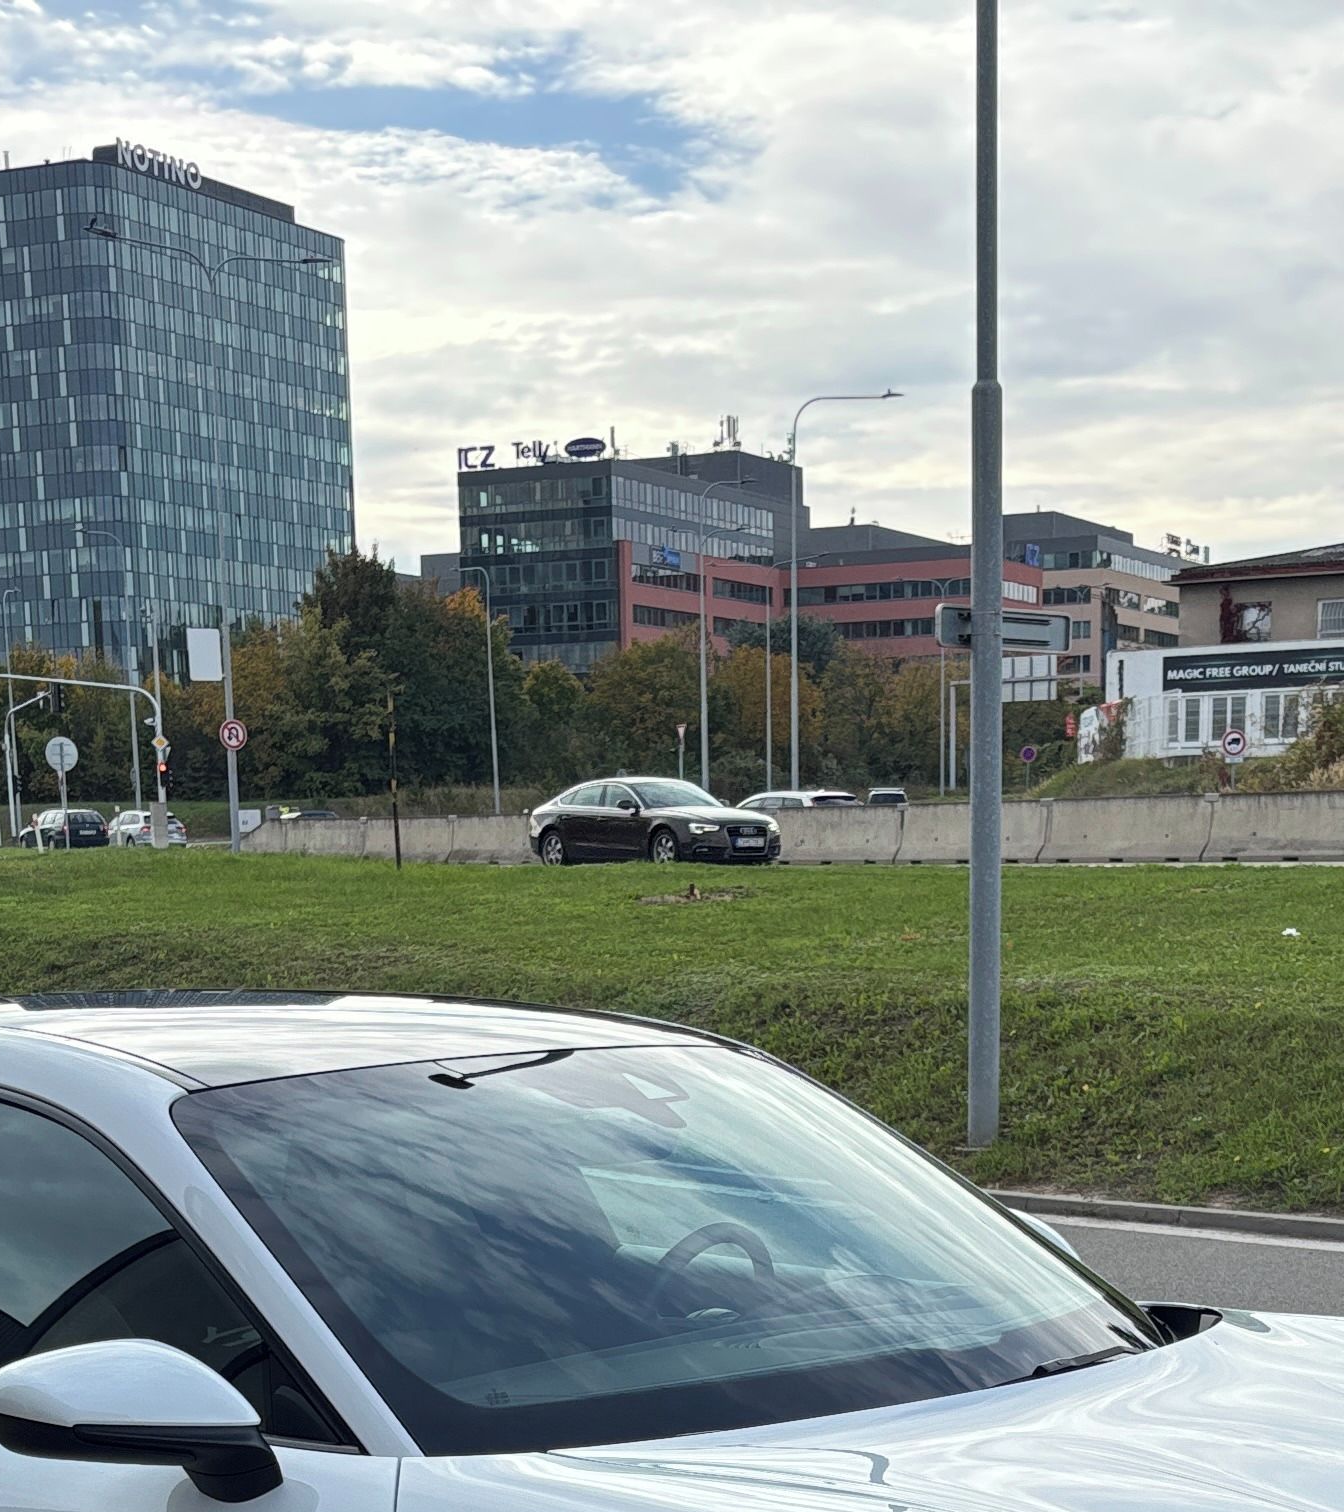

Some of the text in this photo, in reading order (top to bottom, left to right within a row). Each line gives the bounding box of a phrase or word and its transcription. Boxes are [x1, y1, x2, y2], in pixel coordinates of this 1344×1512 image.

[116, 136, 202, 190] NOTINO
[457, 445, 495, 470] ICZ
[511, 440, 550, 463] Telly
[1167, 668, 1204, 681] MAGIC
[1205, 666, 1232, 679] FREE
[1282, 659, 1327, 674] TANEČNÍ
